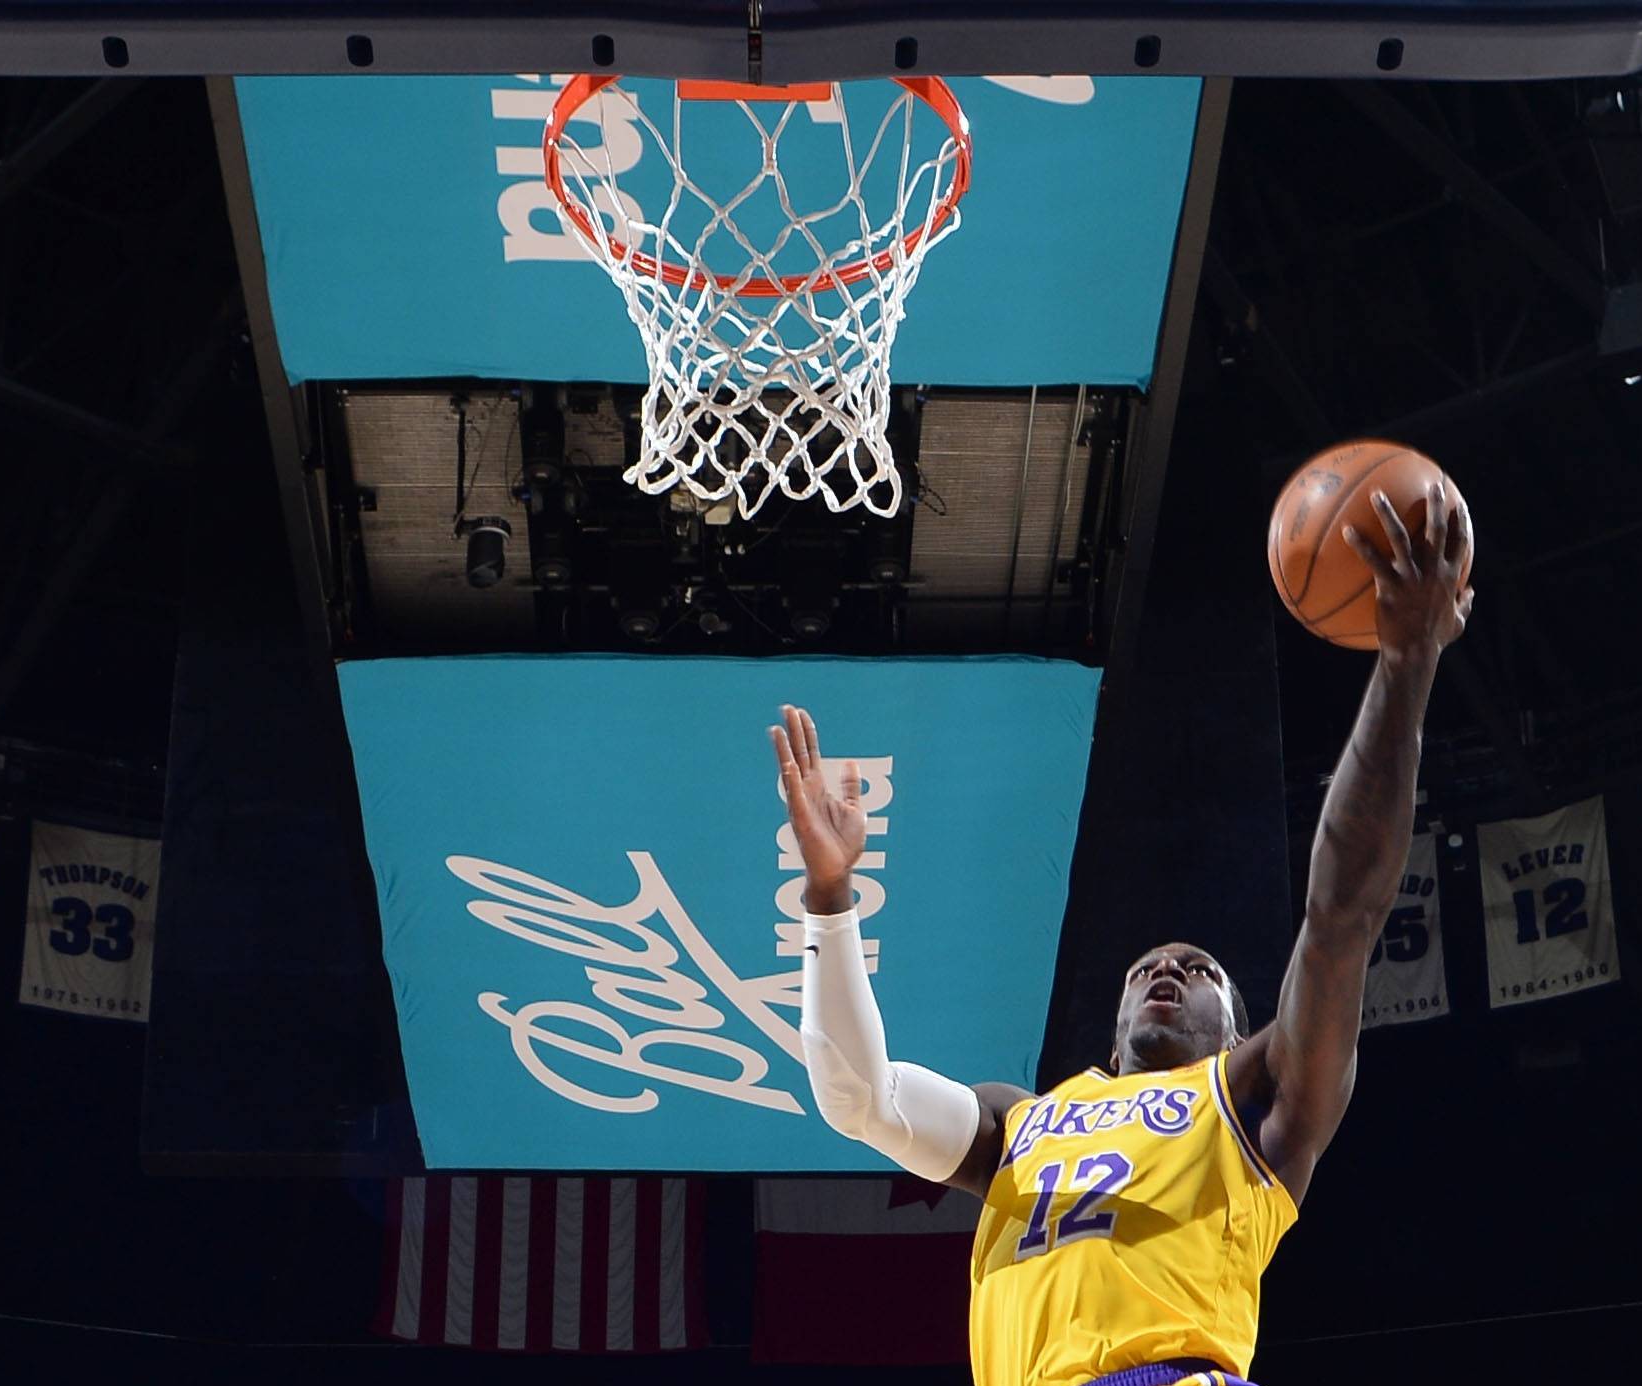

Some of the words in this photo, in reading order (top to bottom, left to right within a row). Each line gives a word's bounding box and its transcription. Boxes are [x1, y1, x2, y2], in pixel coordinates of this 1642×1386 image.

[39, 864, 150, 901] THOMPSON
[1501, 843, 1585, 883] LEVER
[50, 897, 136, 963] 33
[1513, 877, 1589, 945] 12
[446, 851, 806, 1114] Ball
[1500, 962, 1609, 998] 1984-1990
[1001, 1088, 1198, 1169] LAKERS
[1014, 1150, 1134, 1262] 12
